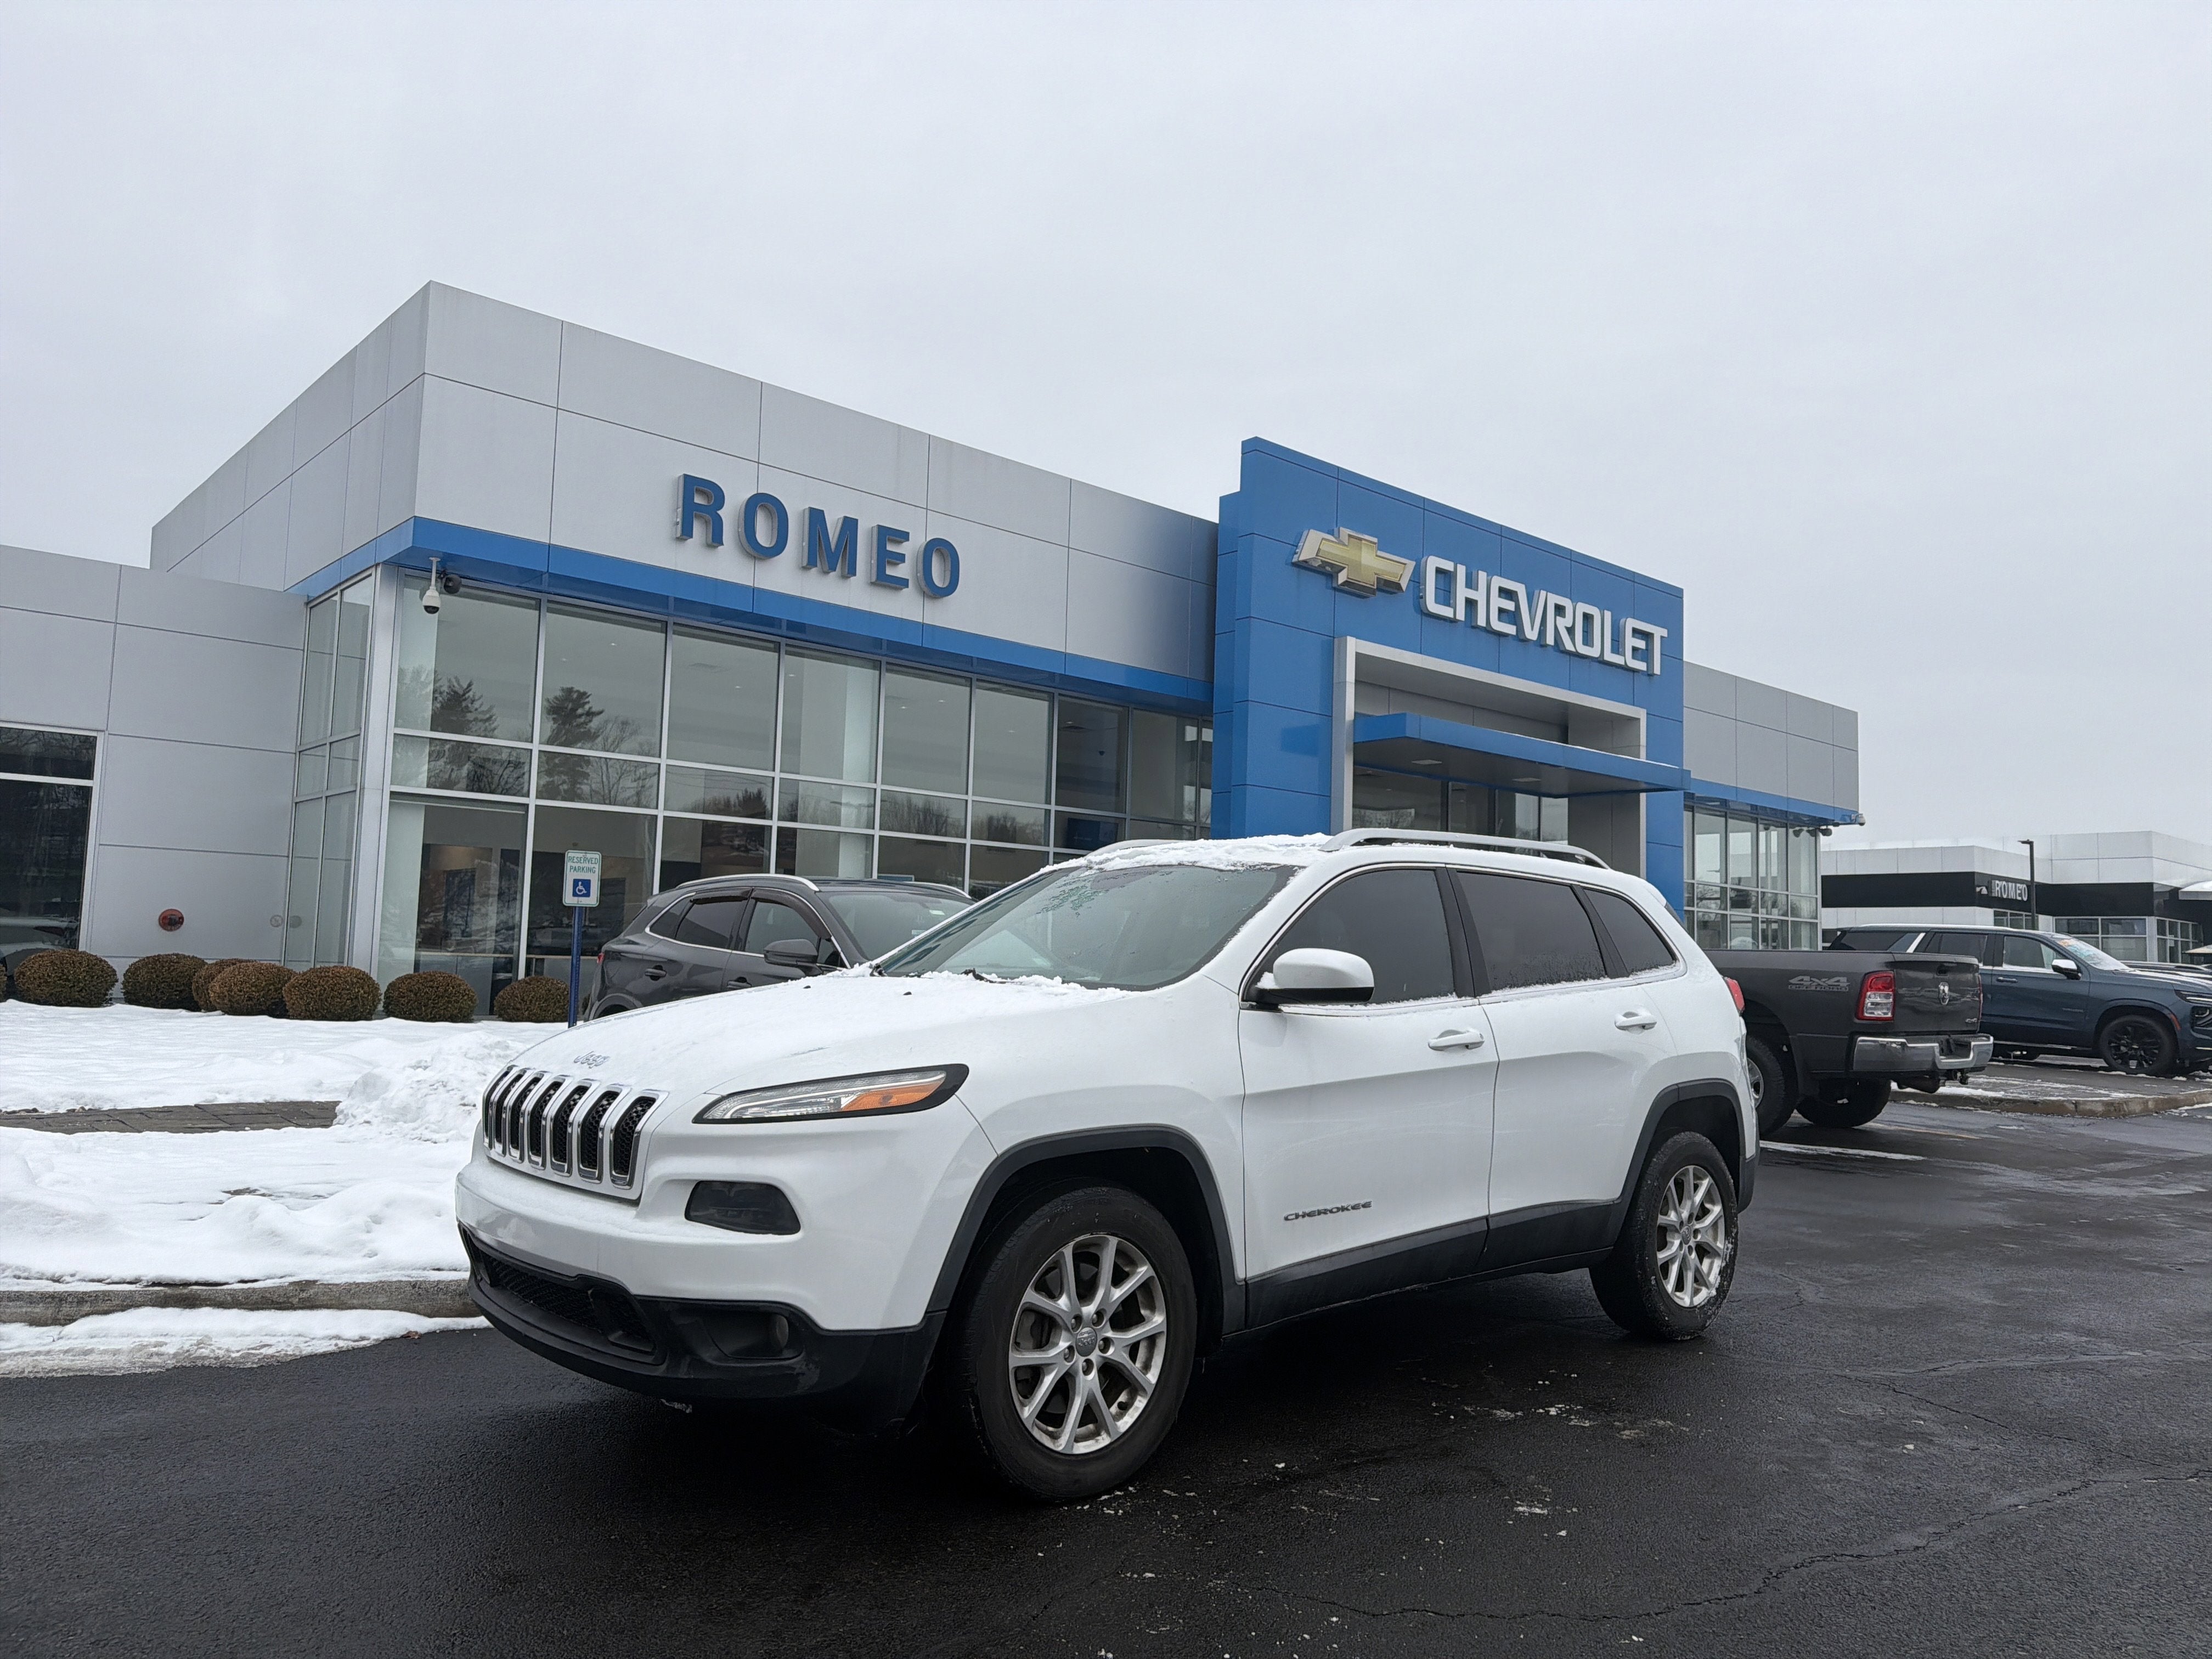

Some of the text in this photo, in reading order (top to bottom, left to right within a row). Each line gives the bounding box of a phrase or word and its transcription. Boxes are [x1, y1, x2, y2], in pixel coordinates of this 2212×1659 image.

[676, 473, 960, 599] ROMEO
[1420, 555, 1668, 675] CHEVROLET
[568, 856, 599, 865] RESERVED
[569, 865, 596, 873] PARKING
[1995, 880, 2028, 901] ROMEO
[573, 1051, 610, 1069] Jeep
[1284, 1200, 1372, 1221] CHEROKEE
